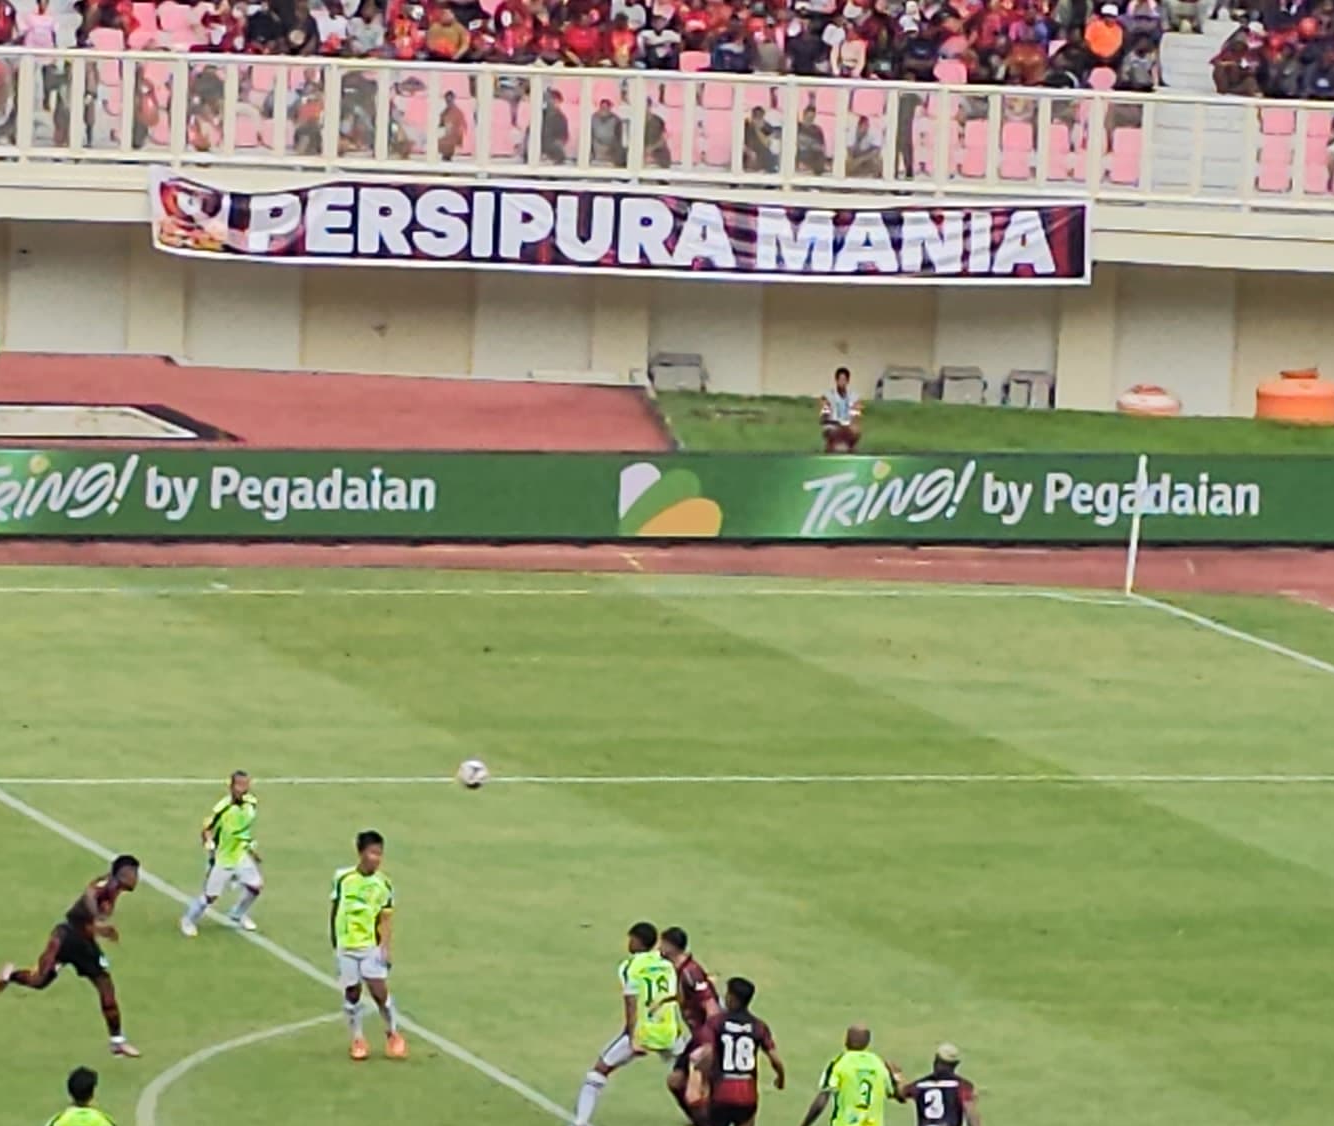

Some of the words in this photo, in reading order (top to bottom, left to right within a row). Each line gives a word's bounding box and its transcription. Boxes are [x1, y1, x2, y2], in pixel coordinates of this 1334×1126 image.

[247, 185, 737, 269] PERSIPURA
[756, 206, 1056, 275] MANIA
[145, 465, 198, 520] by
[209, 466, 437, 521] Pegadaian
[981, 471, 1033, 524] by
[1043, 472, 1261, 527] Pegadaian
[720, 1033, 756, 1072] 18
[924, 1088, 946, 1120] 3
